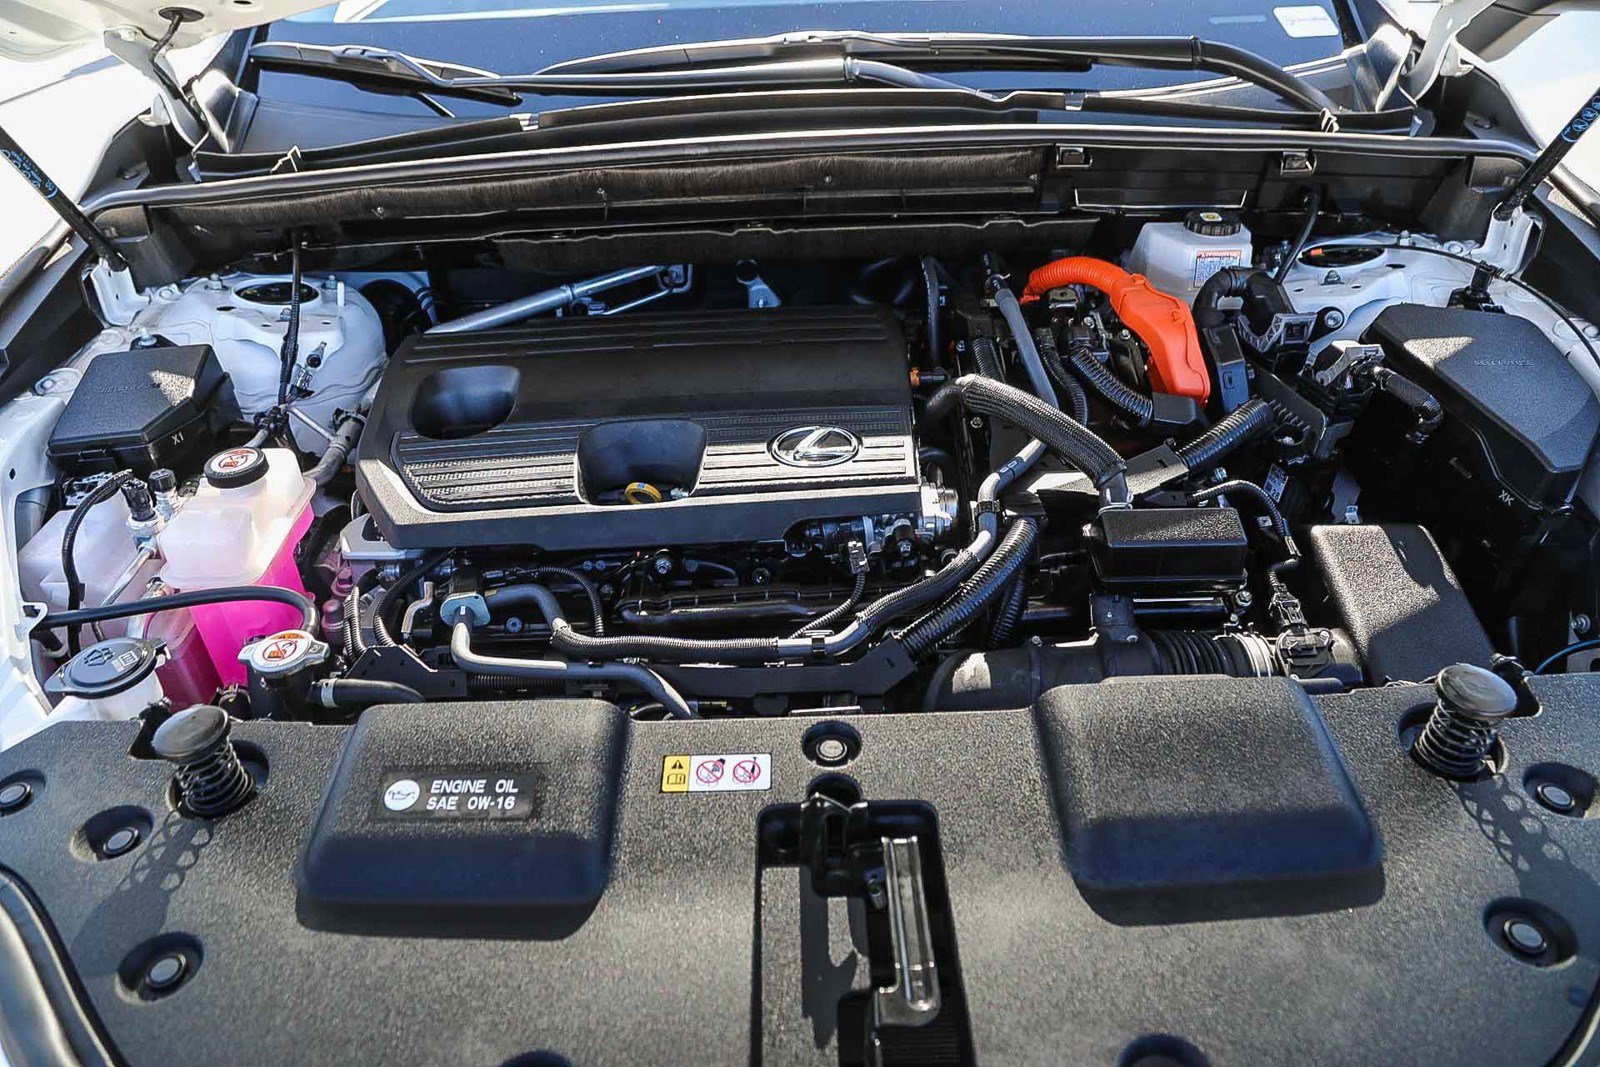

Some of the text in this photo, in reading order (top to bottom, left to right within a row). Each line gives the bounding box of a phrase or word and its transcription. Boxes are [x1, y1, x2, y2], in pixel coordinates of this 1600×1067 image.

[430, 779, 519, 794] ENGINE OIL
[426, 796, 459, 810] SAE
